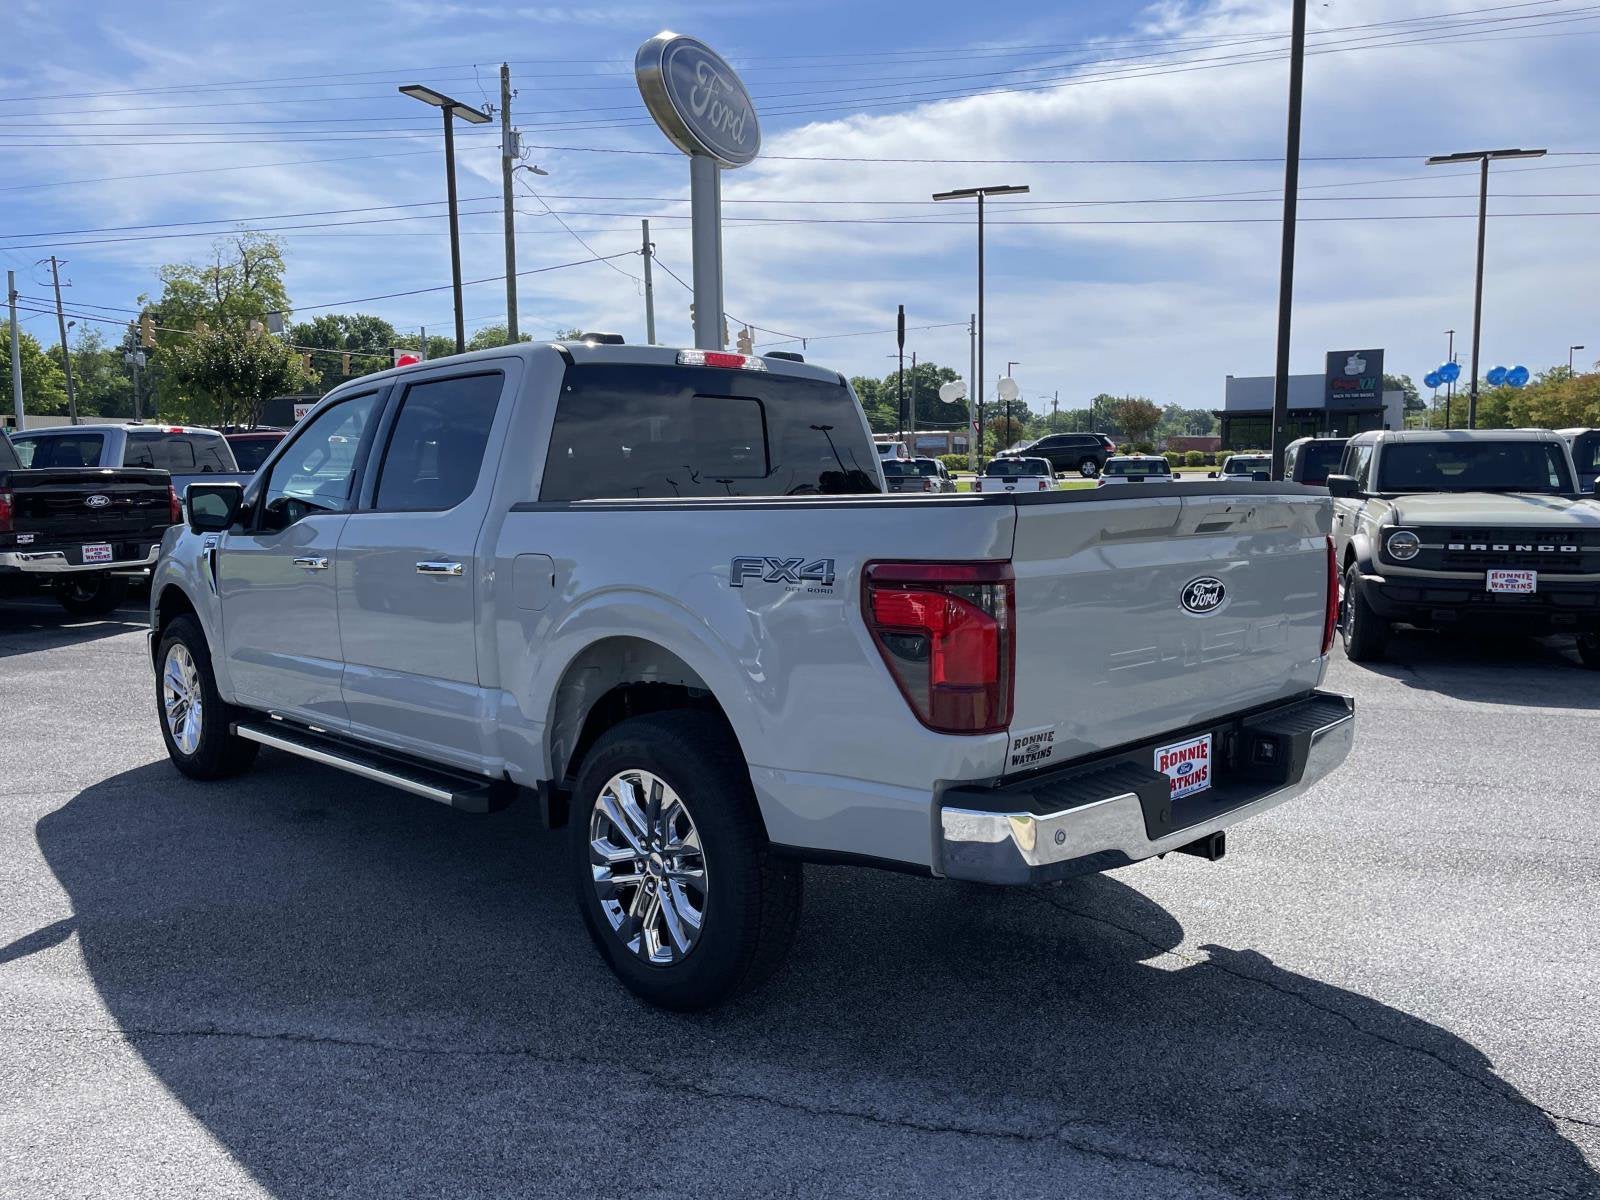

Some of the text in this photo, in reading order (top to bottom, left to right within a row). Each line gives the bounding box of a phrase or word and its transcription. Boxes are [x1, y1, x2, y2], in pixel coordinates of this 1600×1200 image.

[690, 60, 746, 144] Ford
[1448, 543, 1577, 552] BRONCO
[729, 555, 836, 588] FX4
[1491, 572, 1533, 581] RONNIE
[807, 587, 834, 595] ROAD
[1491, 581, 1533, 589] WATKINS
[1190, 583, 1220, 608] Ford
[1013, 731, 1055, 751] RONNIE
[1011, 746, 1053, 766] WATKINS
[1159, 743, 1208, 772] RONNIE
[1170, 765, 1208, 792] ATKINS
